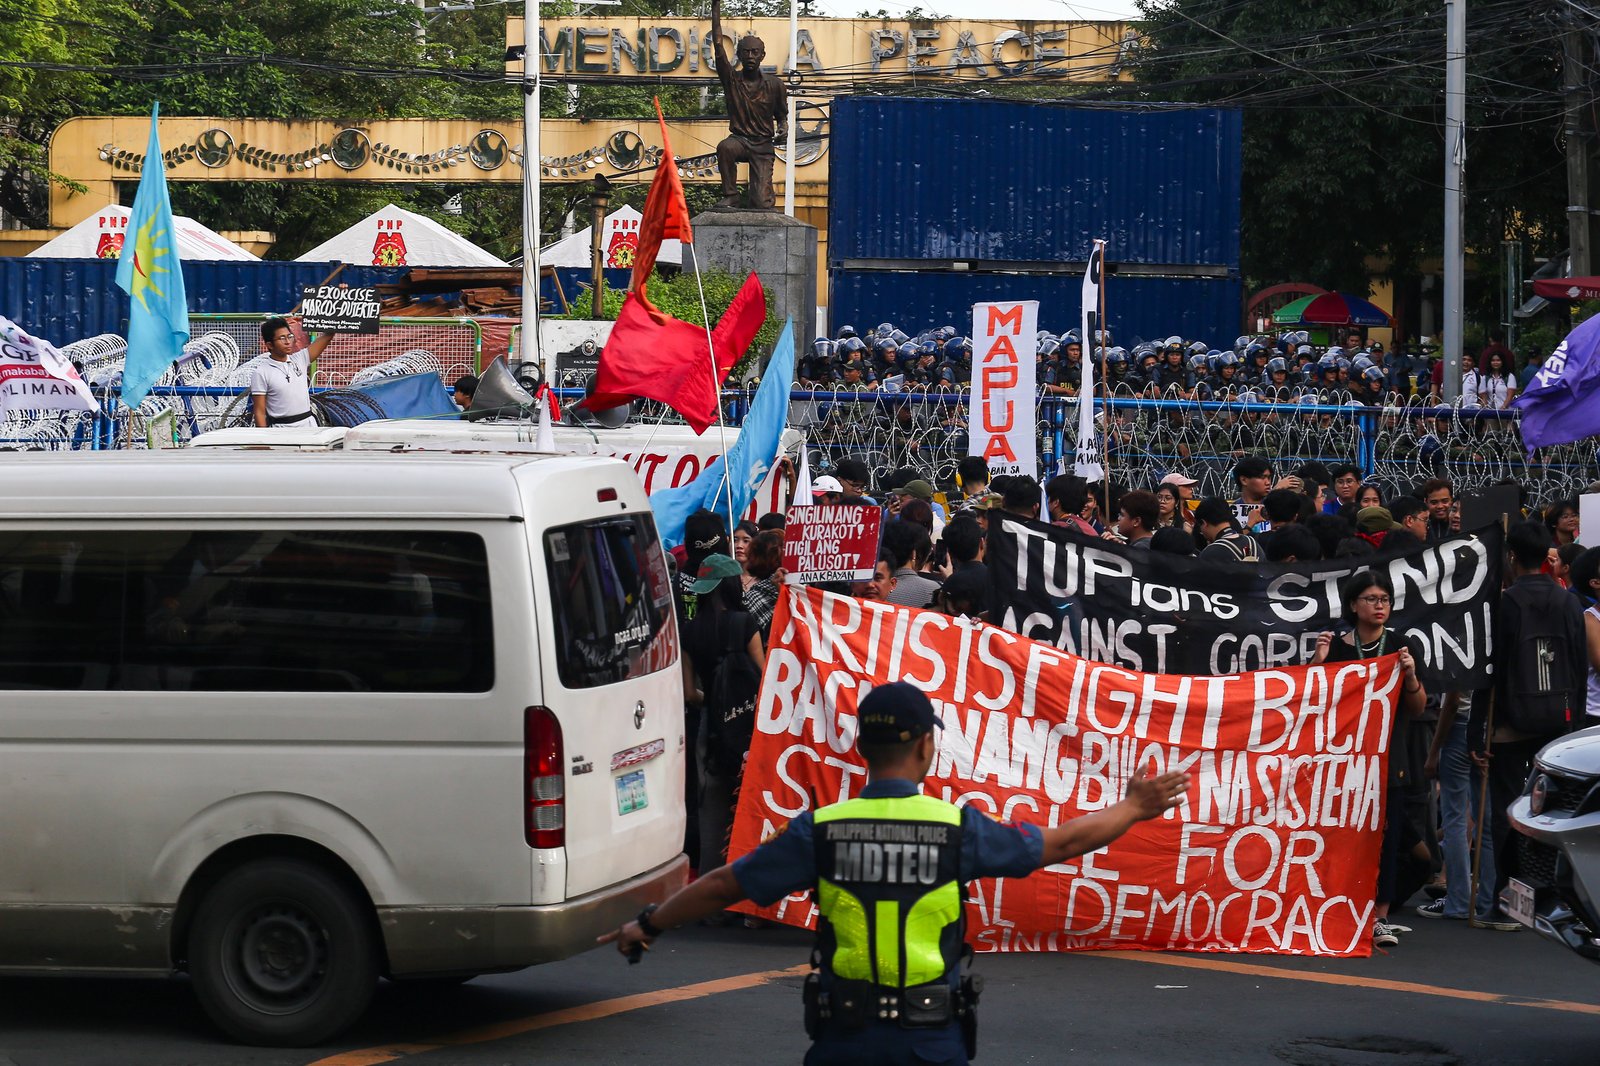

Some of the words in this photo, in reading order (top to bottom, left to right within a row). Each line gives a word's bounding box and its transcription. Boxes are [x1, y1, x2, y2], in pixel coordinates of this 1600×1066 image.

[539, 26, 825, 75] MENDIOA
[869, 28, 1068, 77] PEACE
[98, 216, 128, 228] PNP
[377, 219, 403, 230] PNP
[612, 219, 638, 230] PNP
[316, 286, 376, 302] EXORCISE
[1585, 289, 1600, 298] MI
[3, 383, 77, 396] LIMAN
[981, 304, 1024, 463] MAPUA
[988, 466, 1007, 475] BAN
[1010, 465, 1020, 475] SA
[786, 505, 833, 525] SINGILIN
[833, 505, 864, 525] ANG
[802, 523, 865, 540] KURAKOT!
[815, 540, 840, 556] ANG
[798, 553, 861, 571] PALUSOT!
[1001, 519, 1240, 620] TUPians
[1265, 537, 1488, 622] STND
[800, 570, 855, 582] ANAKBAYAN
[781, 583, 1018, 712] ARTISTS
[1021, 642, 1241, 750] FIGHT
[1247, 660, 1400, 756] BACK
[762, 743, 1120, 882] STGGLE
[1175, 822, 1326, 899] FOR
[826, 823, 874, 841] PHILIPPINE
[875, 824, 916, 842] NATIONAL
[917, 826, 948, 844] POLICE
[834, 842, 939, 885] MDTEU
[1063, 877, 1375, 954] DEMOCRACY
